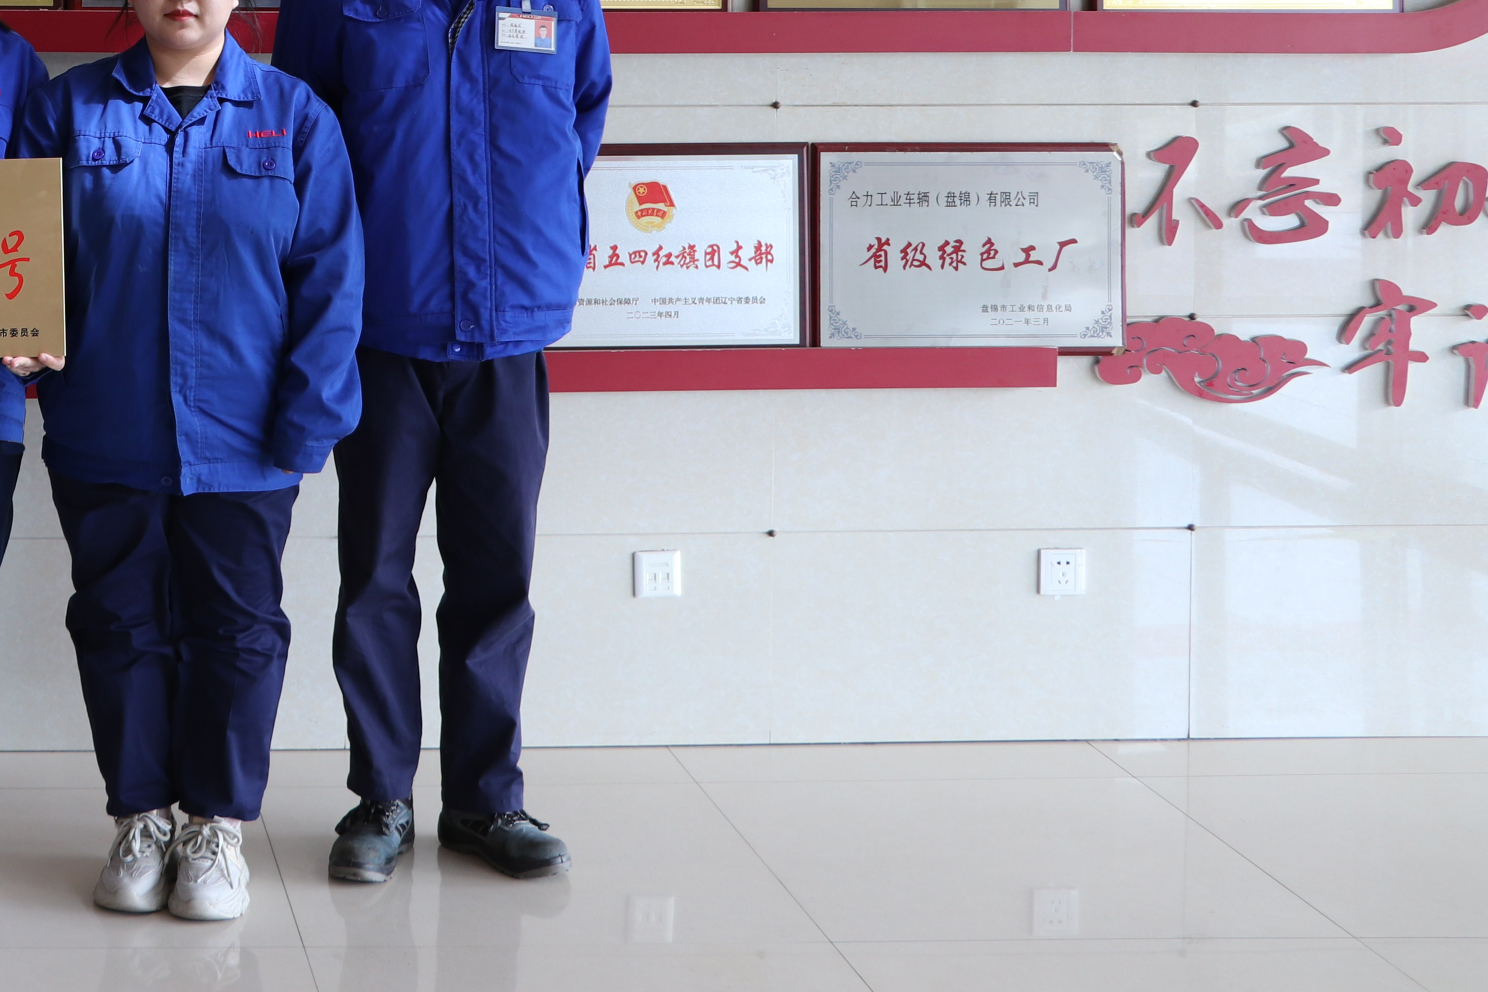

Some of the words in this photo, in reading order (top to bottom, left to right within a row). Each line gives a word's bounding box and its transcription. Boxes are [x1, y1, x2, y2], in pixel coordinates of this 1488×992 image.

[247, 128, 287, 139] HELI
[1129, 126, 1488, 247] 不忘初
[848, 191, 1040, 208] 合力工业车辆（盘锦）有限公司
[859, 236, 1079, 274] 省级绿色工厂
[981, 304, 1073, 313] 盘锦市工业和信息化局
